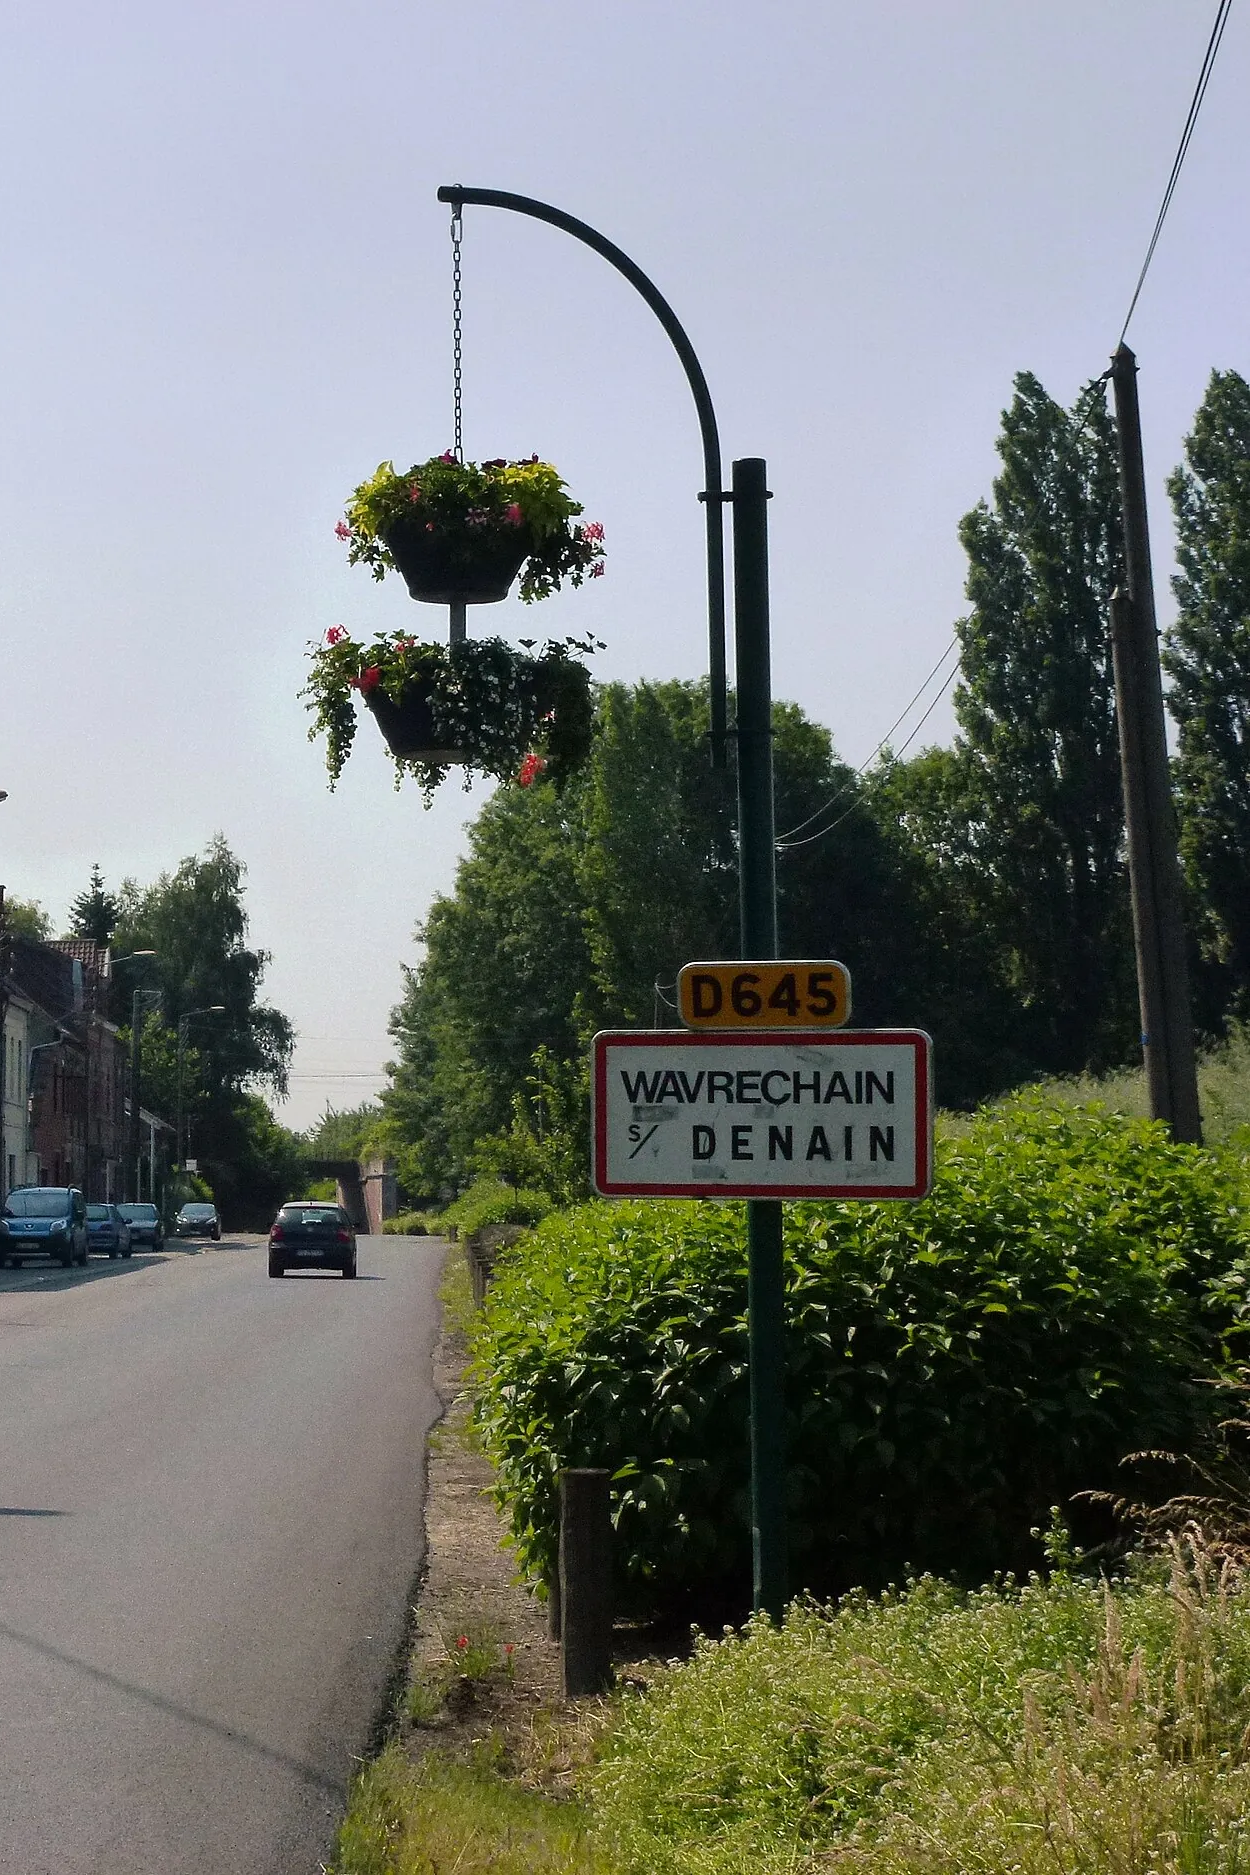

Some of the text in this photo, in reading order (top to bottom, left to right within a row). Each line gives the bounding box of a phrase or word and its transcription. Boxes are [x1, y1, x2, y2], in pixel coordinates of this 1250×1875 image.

[692, 973, 838, 1018] D645
[620, 1070, 895, 1105] WAVRECHAIN
[692, 1124, 895, 1161] DENAIN
